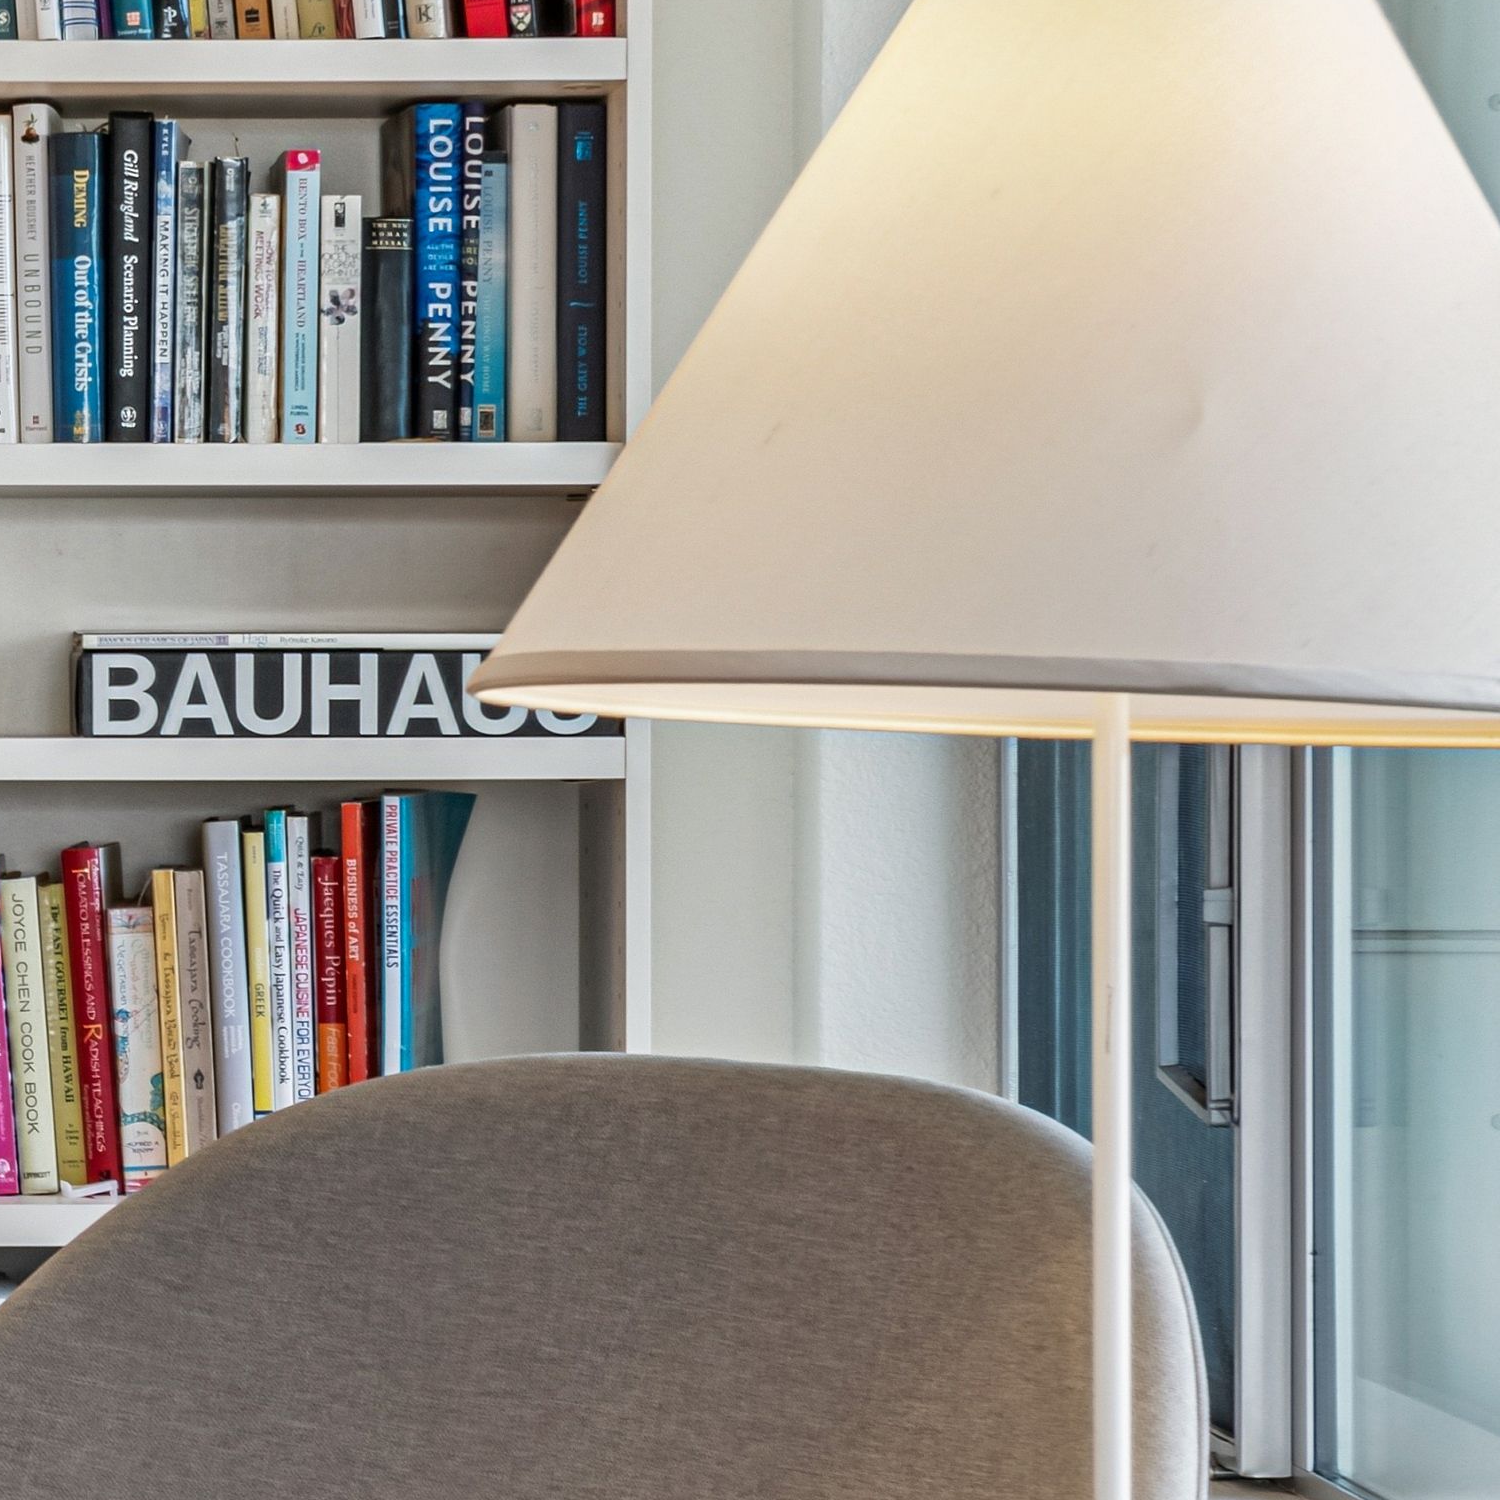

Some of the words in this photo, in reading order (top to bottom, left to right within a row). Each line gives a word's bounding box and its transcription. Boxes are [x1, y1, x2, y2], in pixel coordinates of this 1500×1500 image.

[123, 150, 139, 176] Gill
[428, 118, 453, 232] LOUISE
[73, 170, 90, 227] DEMING
[123, 179, 139, 242] Ringland
[74, 255, 91, 287] Out
[123, 255, 138, 313] Scenario
[23, 254, 43, 354] UNBOUND
[74, 290, 91, 309] of
[75, 311, 92, 338] the
[120, 316, 138, 377] Planning
[428, 282, 453, 389] PENNY
[76, 342, 92, 391] Crisis
[92, 653, 597, 735] BAUHAU
[386, 805, 398, 846] PRIVATE
[346, 859, 359, 918] BUSINESS
[386, 850, 398, 900] PRACTICE
[11, 893, 27, 953] JOYCE
[348, 922, 359, 933] of
[348, 936, 360, 960] ART
[386, 904, 399, 968] ESSENTIALS
[16, 962, 30, 1013] CHEN
[20, 1022, 35, 1073] COOK
[25, 1082, 39, 1134] BOOK
